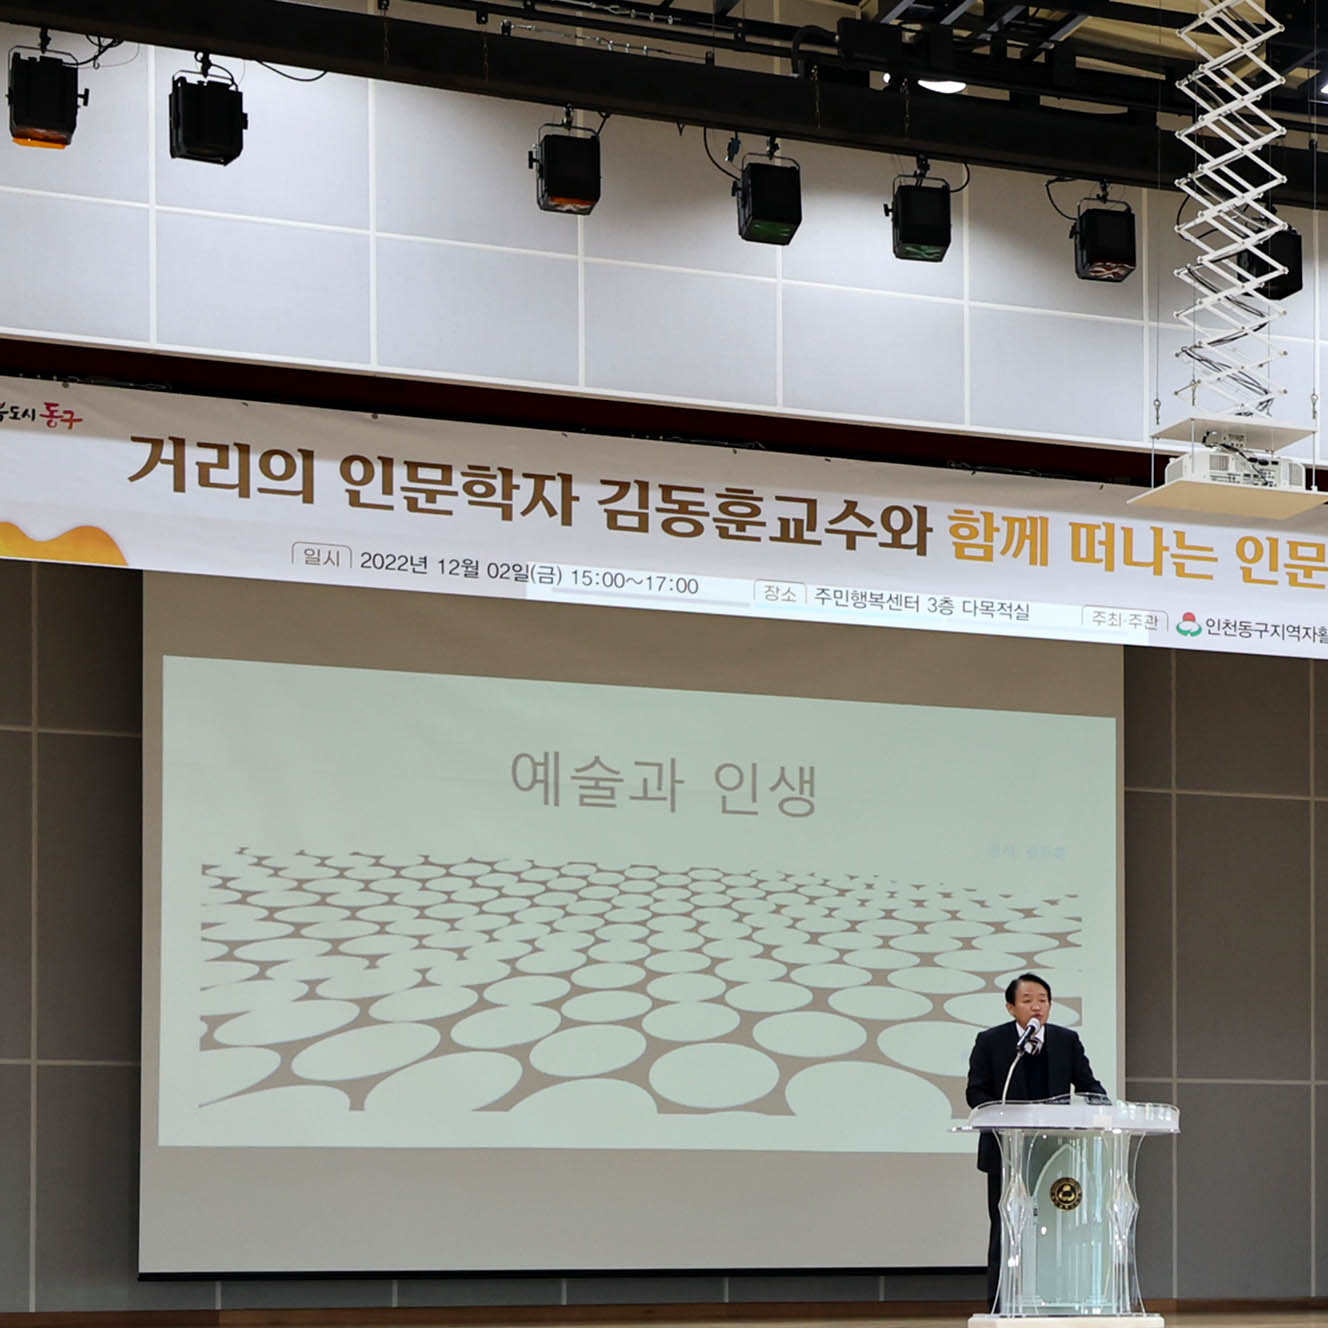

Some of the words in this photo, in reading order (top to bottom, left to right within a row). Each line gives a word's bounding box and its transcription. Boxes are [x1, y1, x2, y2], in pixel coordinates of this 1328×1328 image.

[40, 402, 83, 429] 동구
[128, 436, 314, 504] 거리의
[339, 454, 580, 526] 인문학자
[597, 479, 933, 556] 김동훈교수와
[948, 509, 1049, 567] 함께
[1069, 520, 1218, 580] 떠나는
[304, 548, 340, 568] 일시
[360, 552, 428, 575] 2022년
[438, 558, 479, 579] 12월
[487, 562, 562, 586] 02일(금)
[764, 585, 797, 602] 장소
[815, 587, 920, 612] 주민행복센터
[927, 597, 955, 615] 3층
[962, 600, 1030, 621] 다목적실
[511, 751, 685, 813] 예술과
[714, 762, 816, 818] 인생
